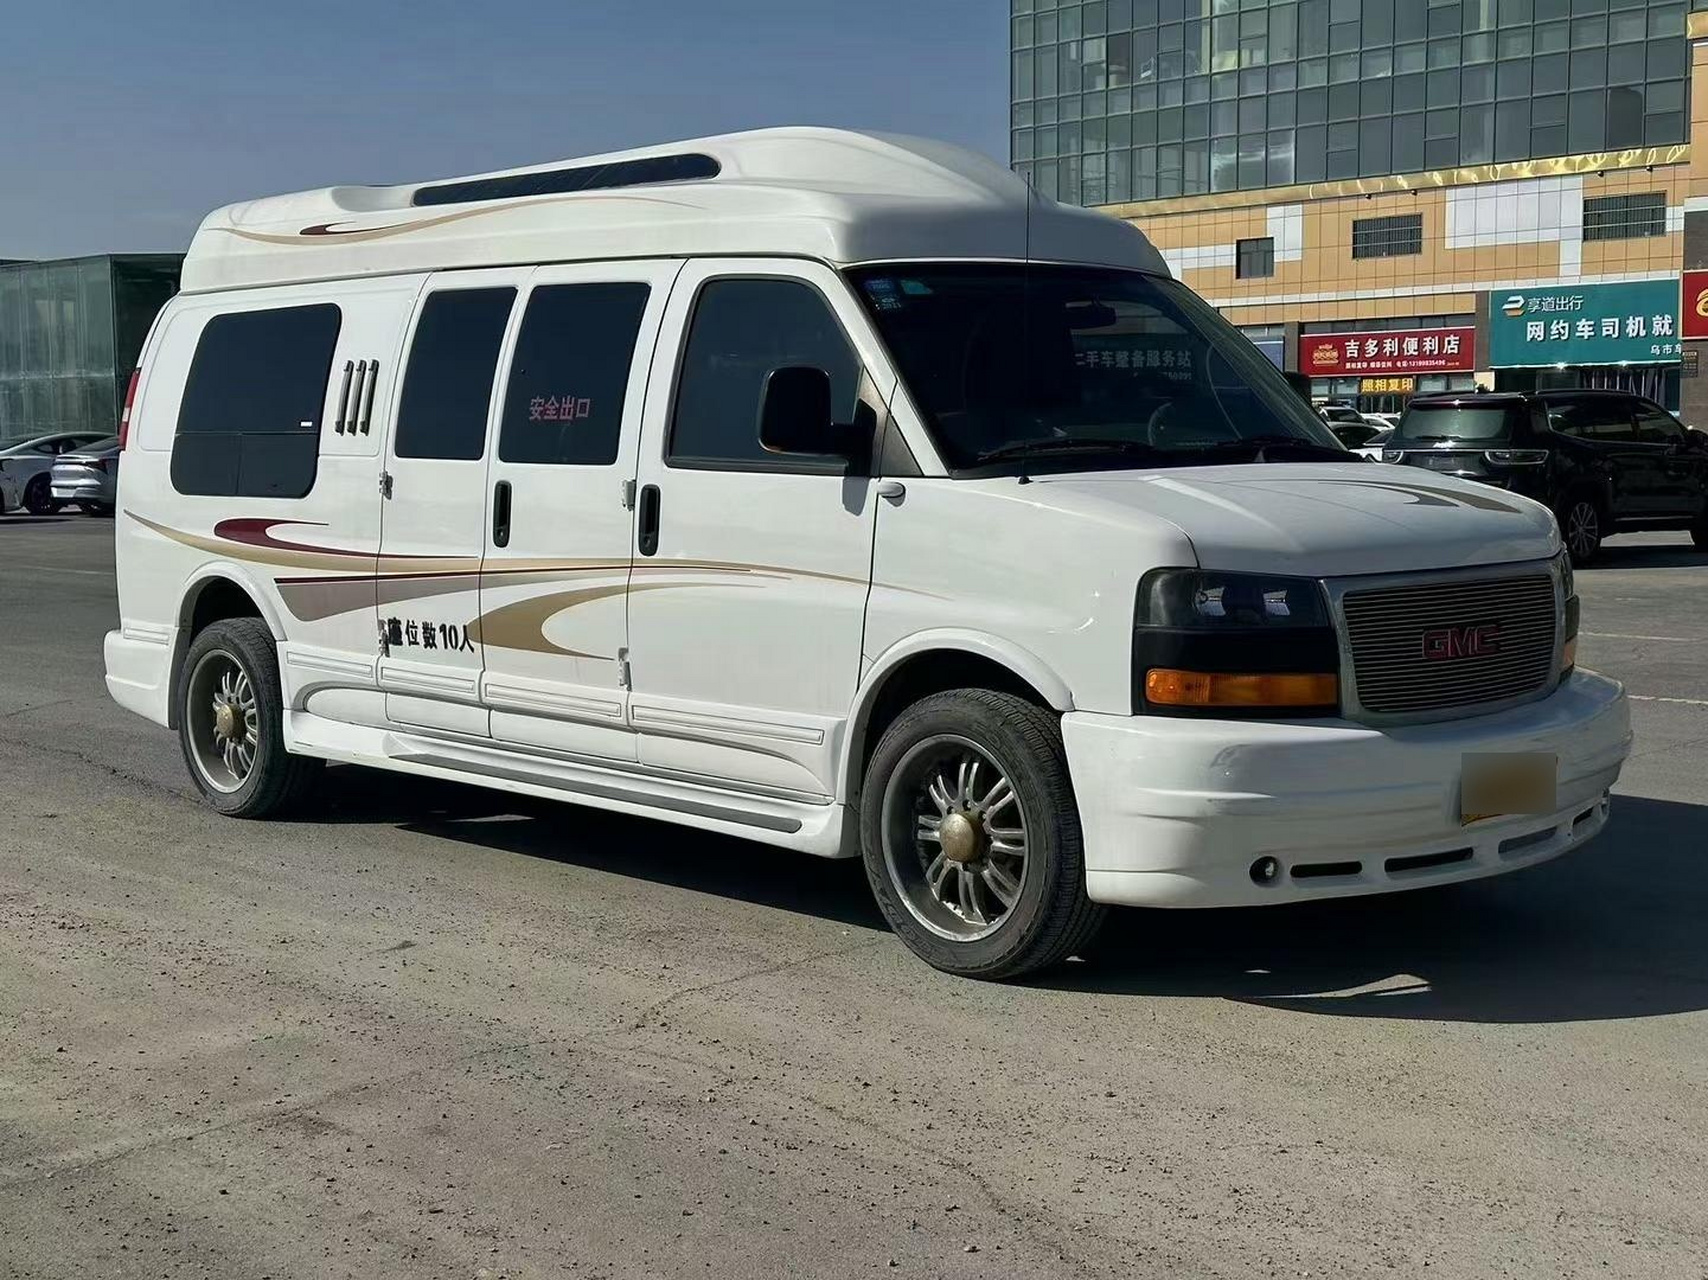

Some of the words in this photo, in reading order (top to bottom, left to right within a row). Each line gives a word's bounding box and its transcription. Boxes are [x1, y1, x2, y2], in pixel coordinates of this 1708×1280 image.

[1527, 295, 1584, 313] 享道出行
[1526, 314, 1674, 342] 网约车司机就
[1344, 335, 1461, 359] 吉多利便利店
[1361, 377, 1414, 393] 照相复印
[529, 396, 591, 421] 安全出口
[1422, 625, 1501, 659] GMC
